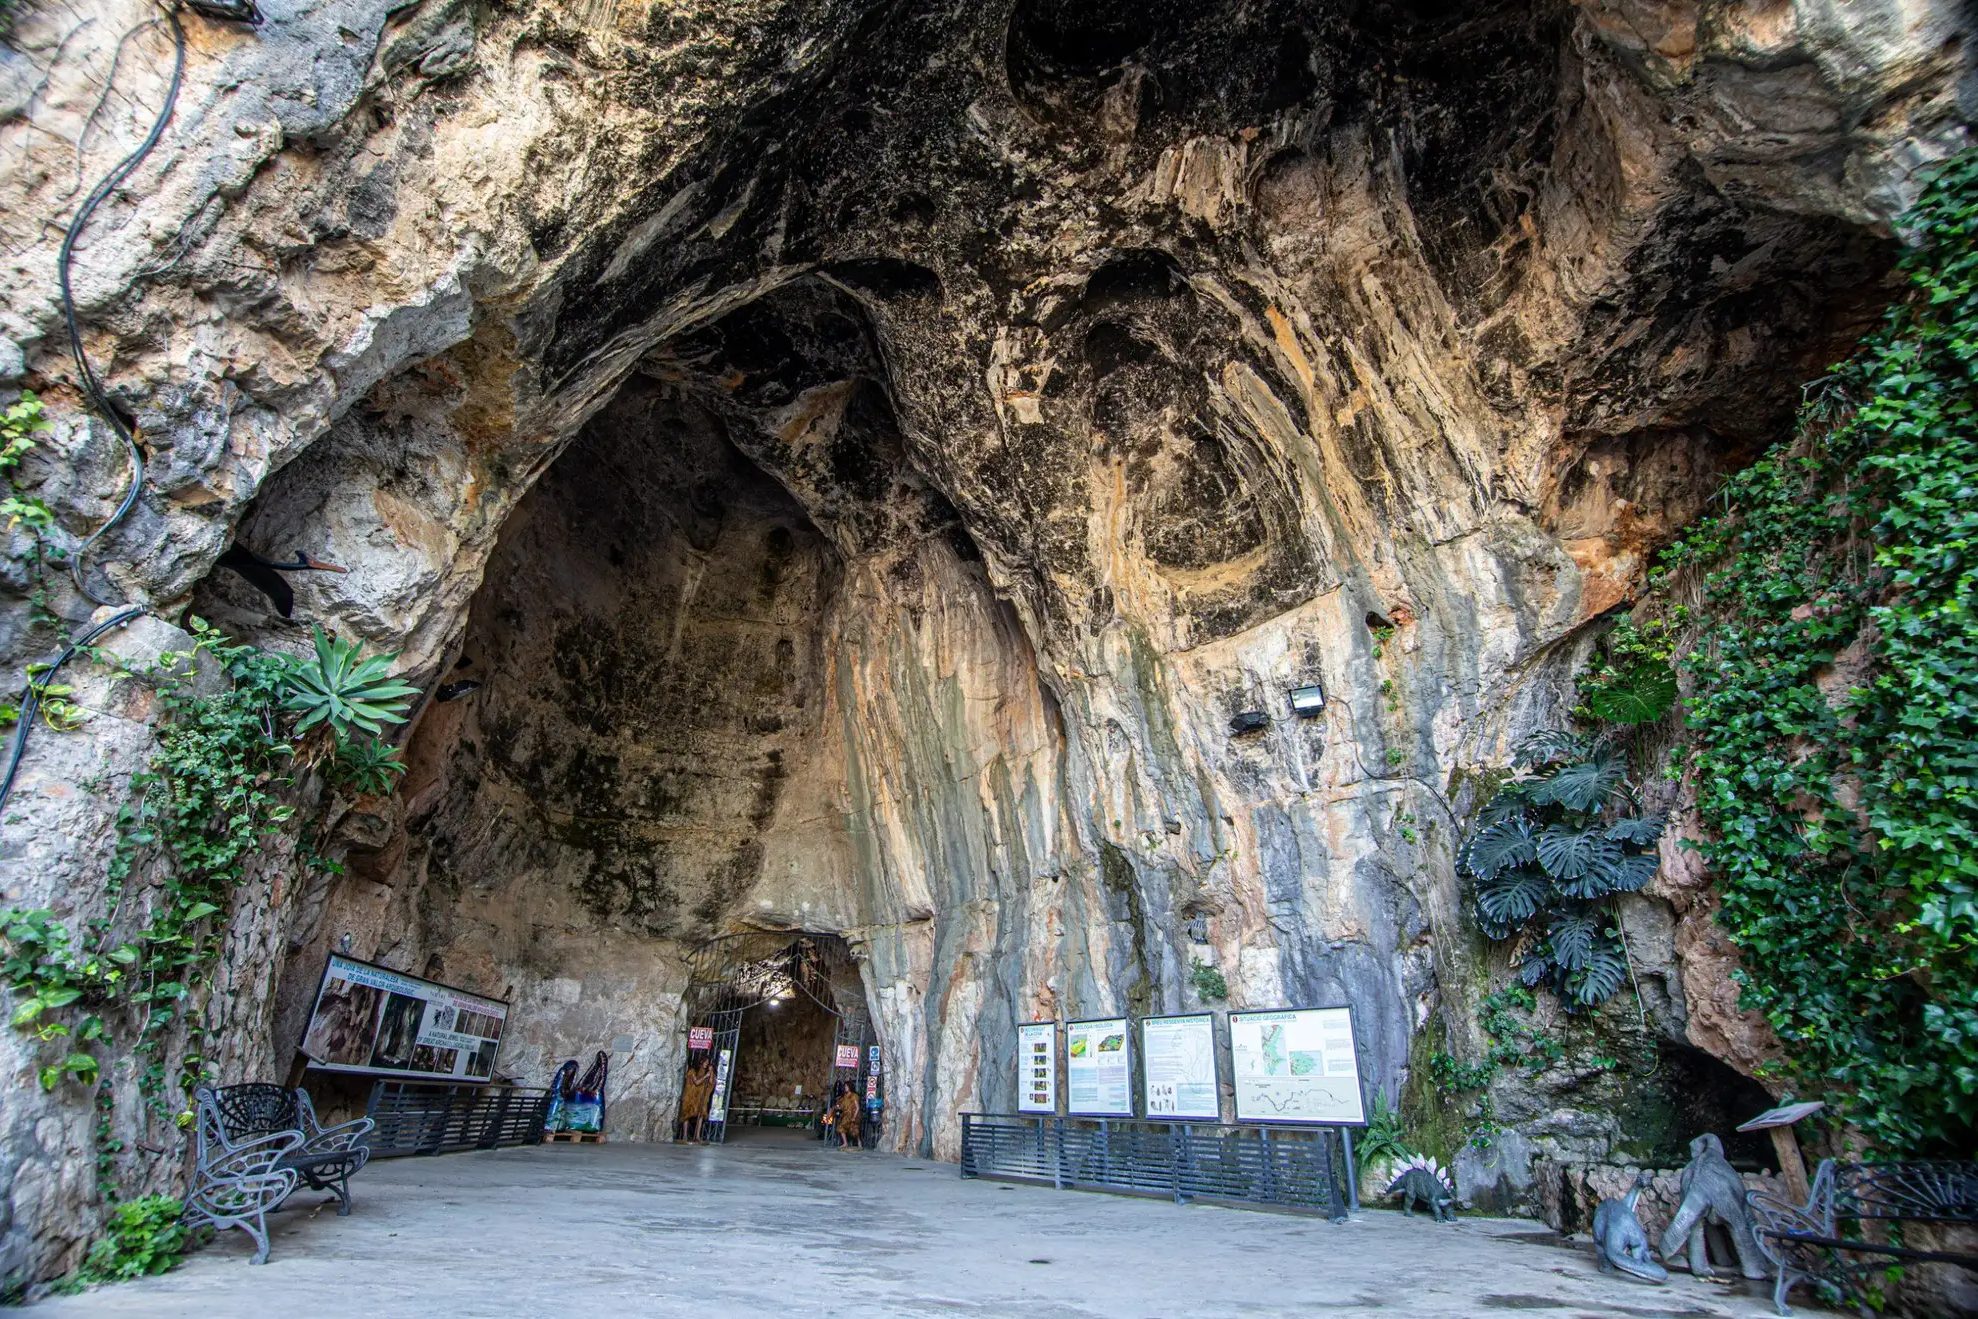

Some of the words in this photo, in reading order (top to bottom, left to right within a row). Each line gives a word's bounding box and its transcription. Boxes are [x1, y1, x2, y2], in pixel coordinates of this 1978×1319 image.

[332, 959, 343, 968] UNA
[347, 973, 355, 981] DE
[355, 975, 370, 984] GRAN
[690, 1028, 713, 1040] CUEVA
[838, 1047, 859, 1059] CUEVA
